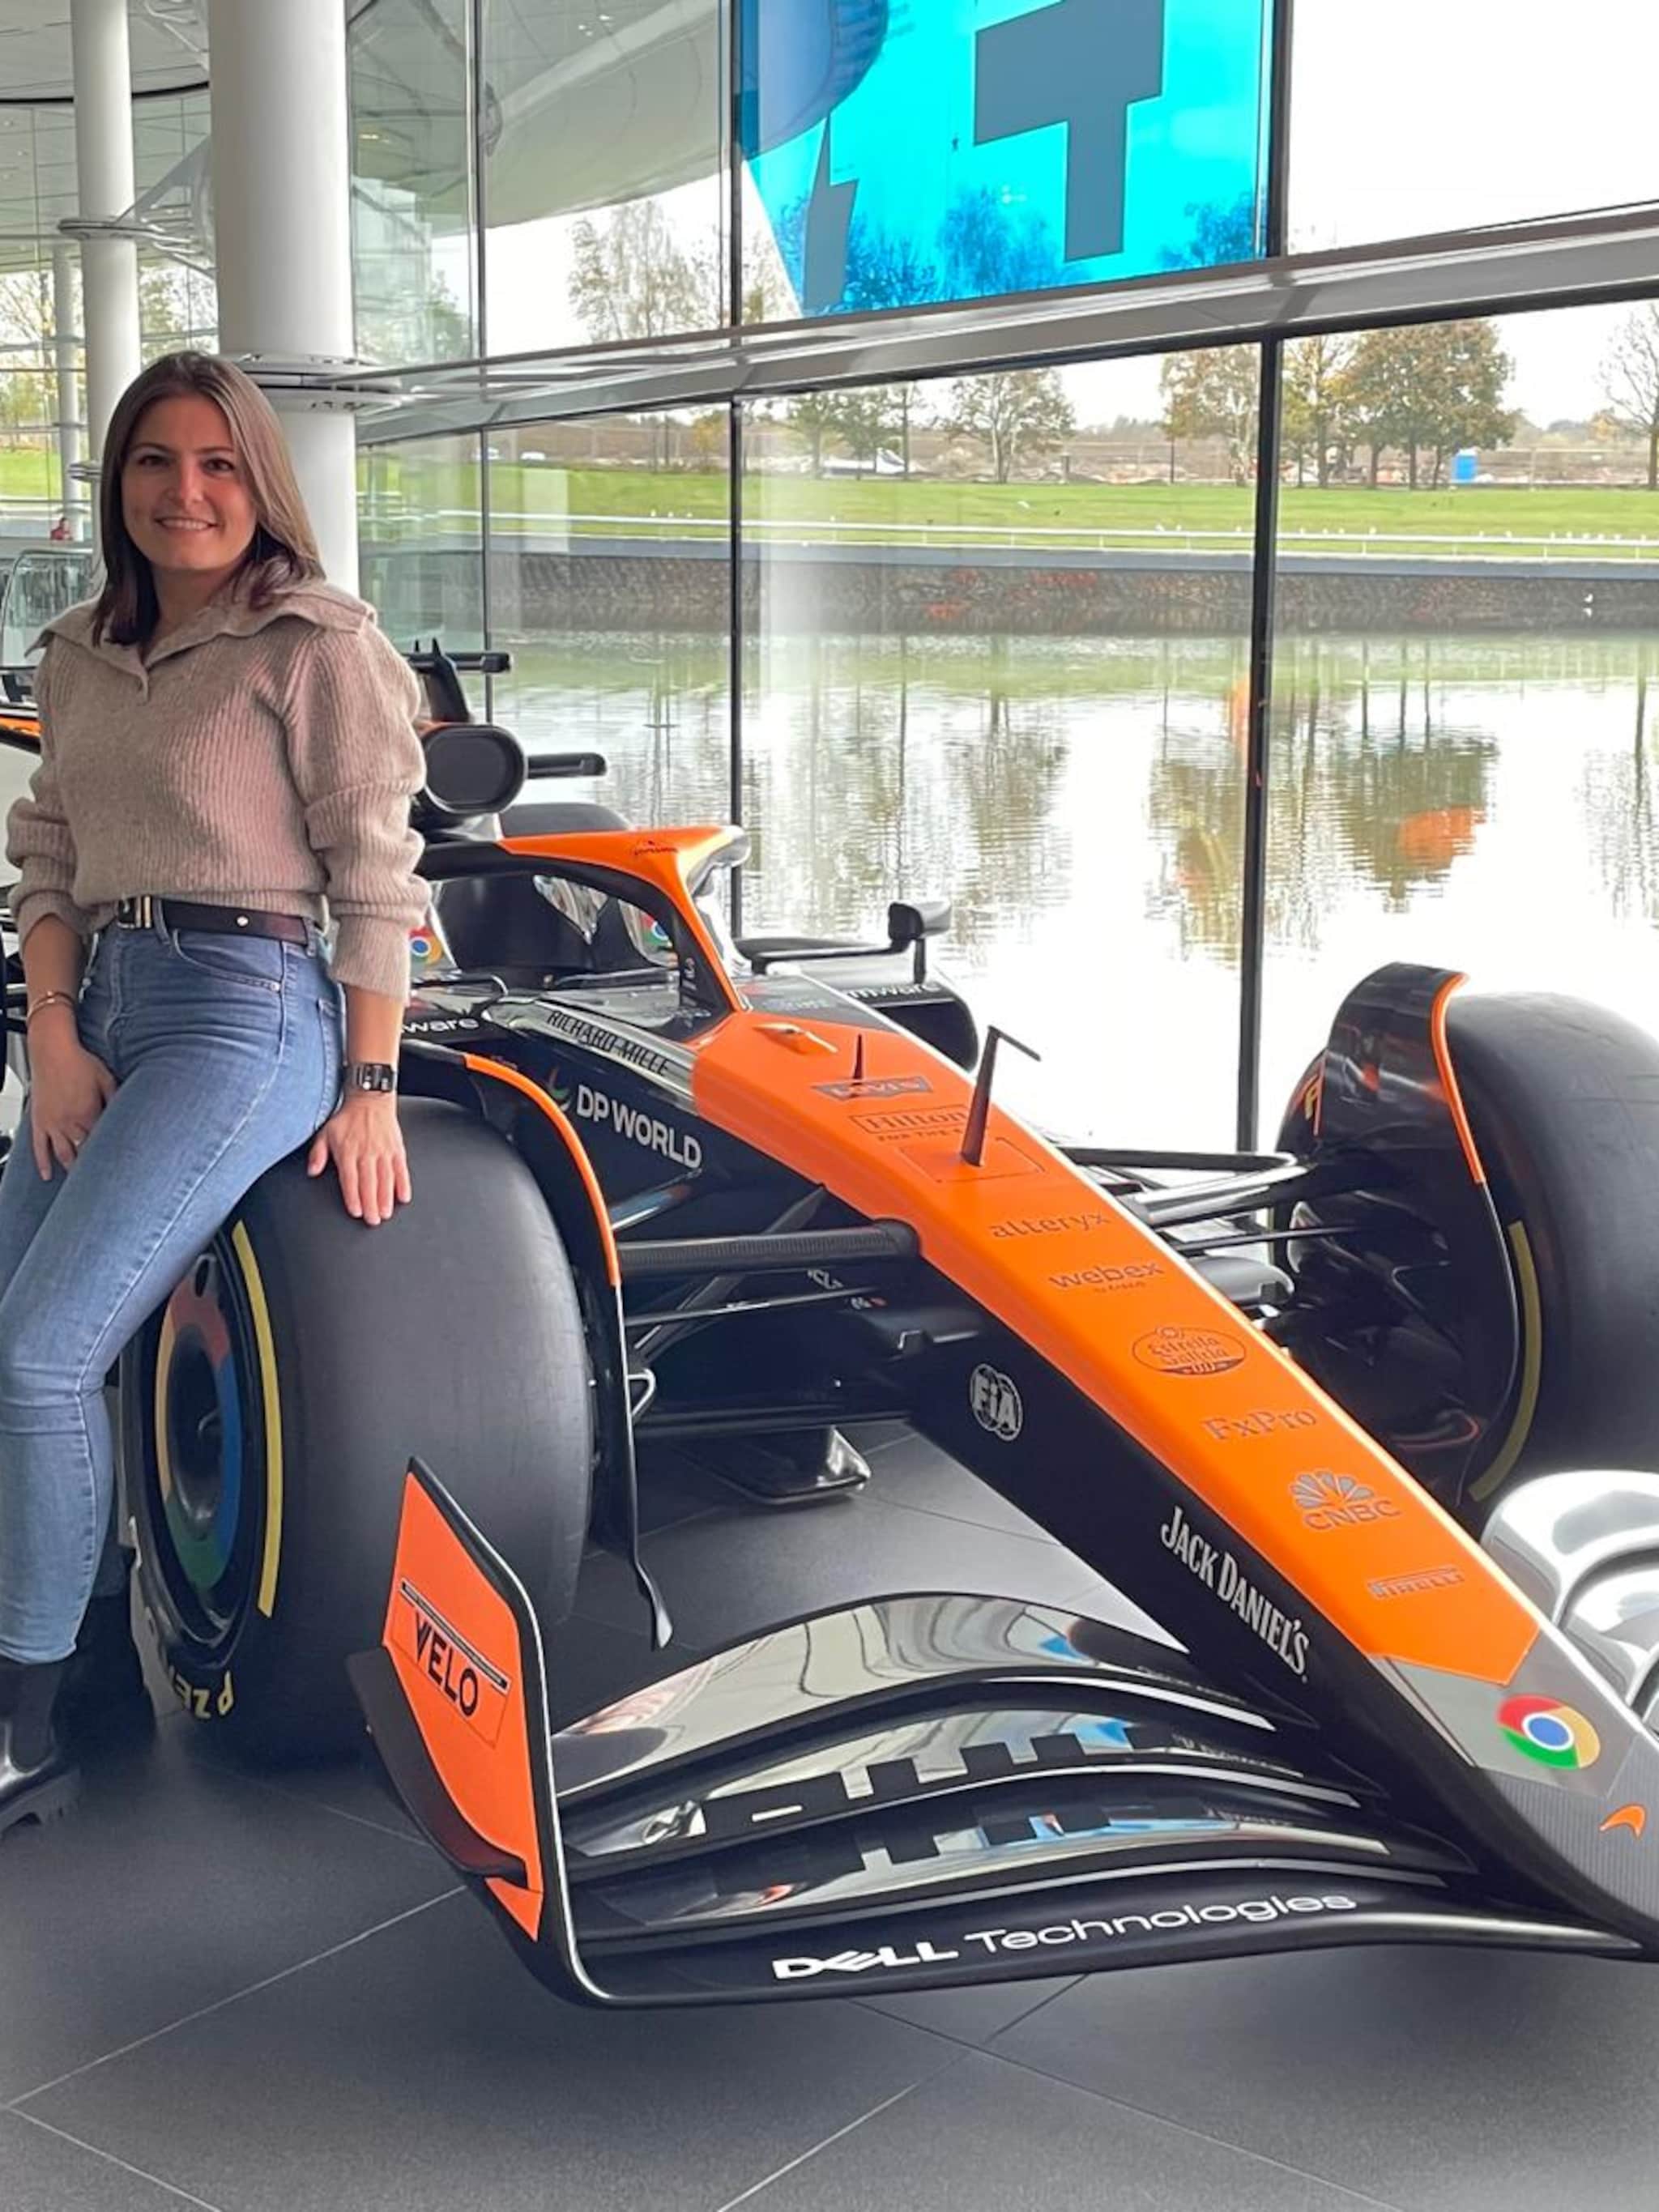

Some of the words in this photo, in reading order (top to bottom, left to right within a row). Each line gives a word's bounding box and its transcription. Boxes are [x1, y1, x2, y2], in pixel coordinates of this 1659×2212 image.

[402, 1017, 480, 1034] ware
[547, 1011, 616, 1053] RICHARD
[620, 1039, 670, 1076] MILLE
[577, 1085, 609, 1123] DP
[612, 1099, 702, 1169] WORLD
[865, 1110, 966, 1129] Hilton
[989, 1212, 1111, 1238] alteryx
[1048, 1262, 1165, 1288] webex
[1203, 1409, 1317, 1440] FxPro
[1303, 1499, 1401, 1530] CNBC
[1161, 1505, 1219, 1589] JACK
[416, 1610, 479, 1717] VELO
[772, 1941, 960, 1980] DELL
[965, 1894, 1358, 1954] Technologies
